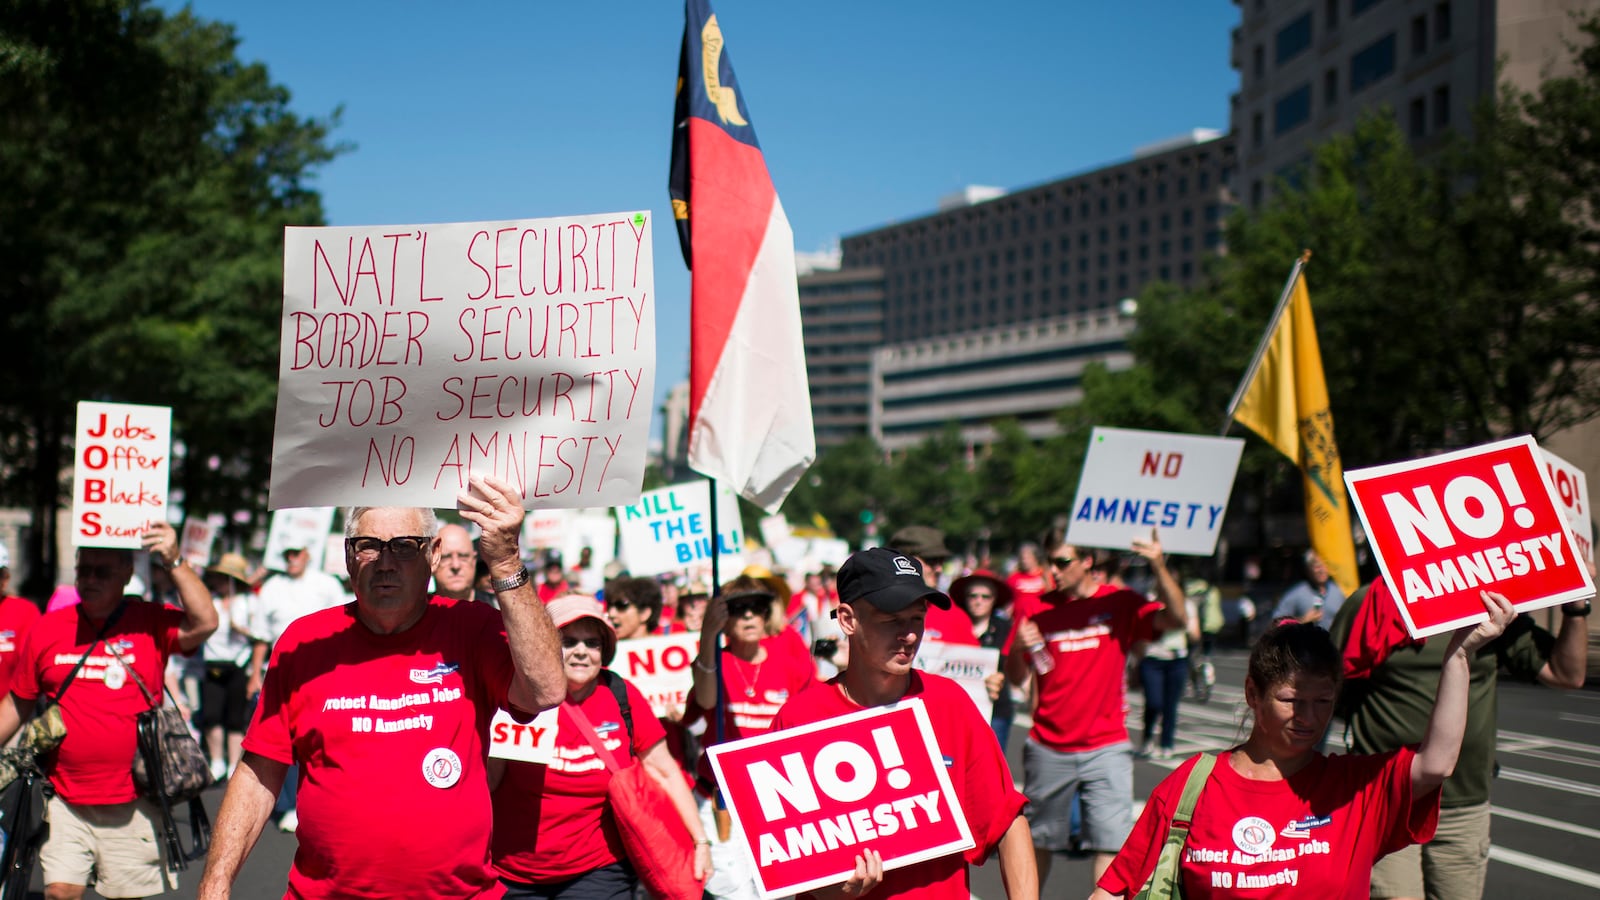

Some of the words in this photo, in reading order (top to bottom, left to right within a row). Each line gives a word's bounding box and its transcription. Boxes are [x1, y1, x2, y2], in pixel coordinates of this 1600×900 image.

[313, 230, 443, 309] NAT'L
[468, 216, 647, 300] SECURITY
[290, 311, 429, 370] BORDER
[454, 293, 646, 362] SECURITY
[319, 376, 407, 428] JOB
[436, 367, 642, 423] SECURITY
[87, 413, 156, 440] Jobs
[83, 445, 163, 471] Offer
[362, 434, 415, 488] NO
[434, 431, 622, 500] AMNESTY
[1140, 450, 1184, 479] NO
[83, 477, 162, 506] Blacks
[625, 491, 684, 520] KILL
[1076, 496, 1223, 530] AMNESTY
[1381, 462, 1535, 557] NO!
[649, 513, 703, 541] THE
[675, 530, 740, 563] BILL!
[1401, 532, 1565, 604] AMNESTY
[322, 695, 366, 712] rotect
[369, 692, 430, 710] American
[432, 687, 461, 703] Jobs
[352, 717, 372, 732] NO
[375, 714, 433, 733] Amnesty
[493, 722, 546, 747] STY
[746, 725, 911, 822] NO!
[759, 790, 942, 867] AMNESTY
[1298, 839, 1330, 856] Jobs
[1211, 871, 1232, 888] NO
[1237, 868, 1298, 888] Amnesty
